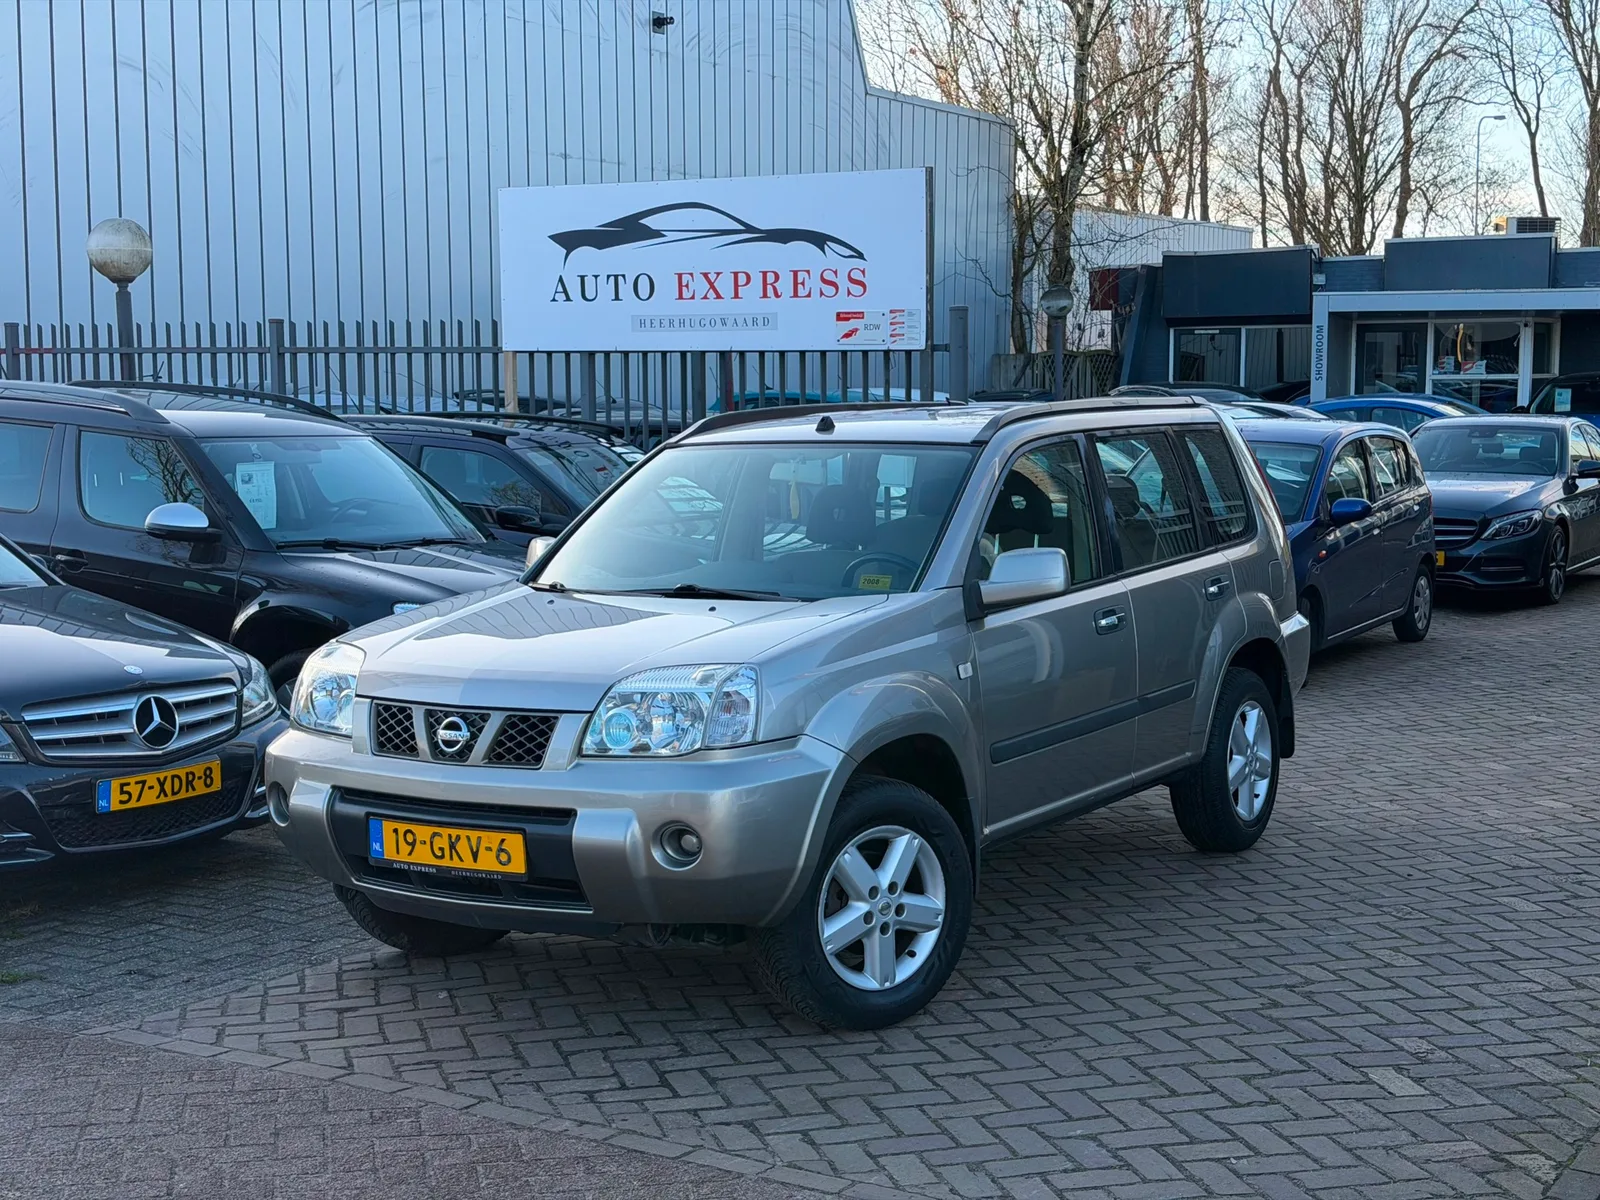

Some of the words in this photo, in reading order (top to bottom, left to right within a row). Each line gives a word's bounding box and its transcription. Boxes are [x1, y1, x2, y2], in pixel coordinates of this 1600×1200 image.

[550, 273, 655, 303] AUTO
[674, 267, 868, 300] EXPRESS
[639, 315, 771, 329] HEERHUGOWAARD
[863, 323, 881, 331] RDW
[1315, 325, 1324, 381] SHOWROOM
[118, 766, 214, 805] 57-XDR-8
[372, 843, 383, 852] NL
[392, 827, 512, 866] 19-GKV-6
[393, 862, 409, 870] AUTO
[410, 865, 437, 873] EXPRESS
